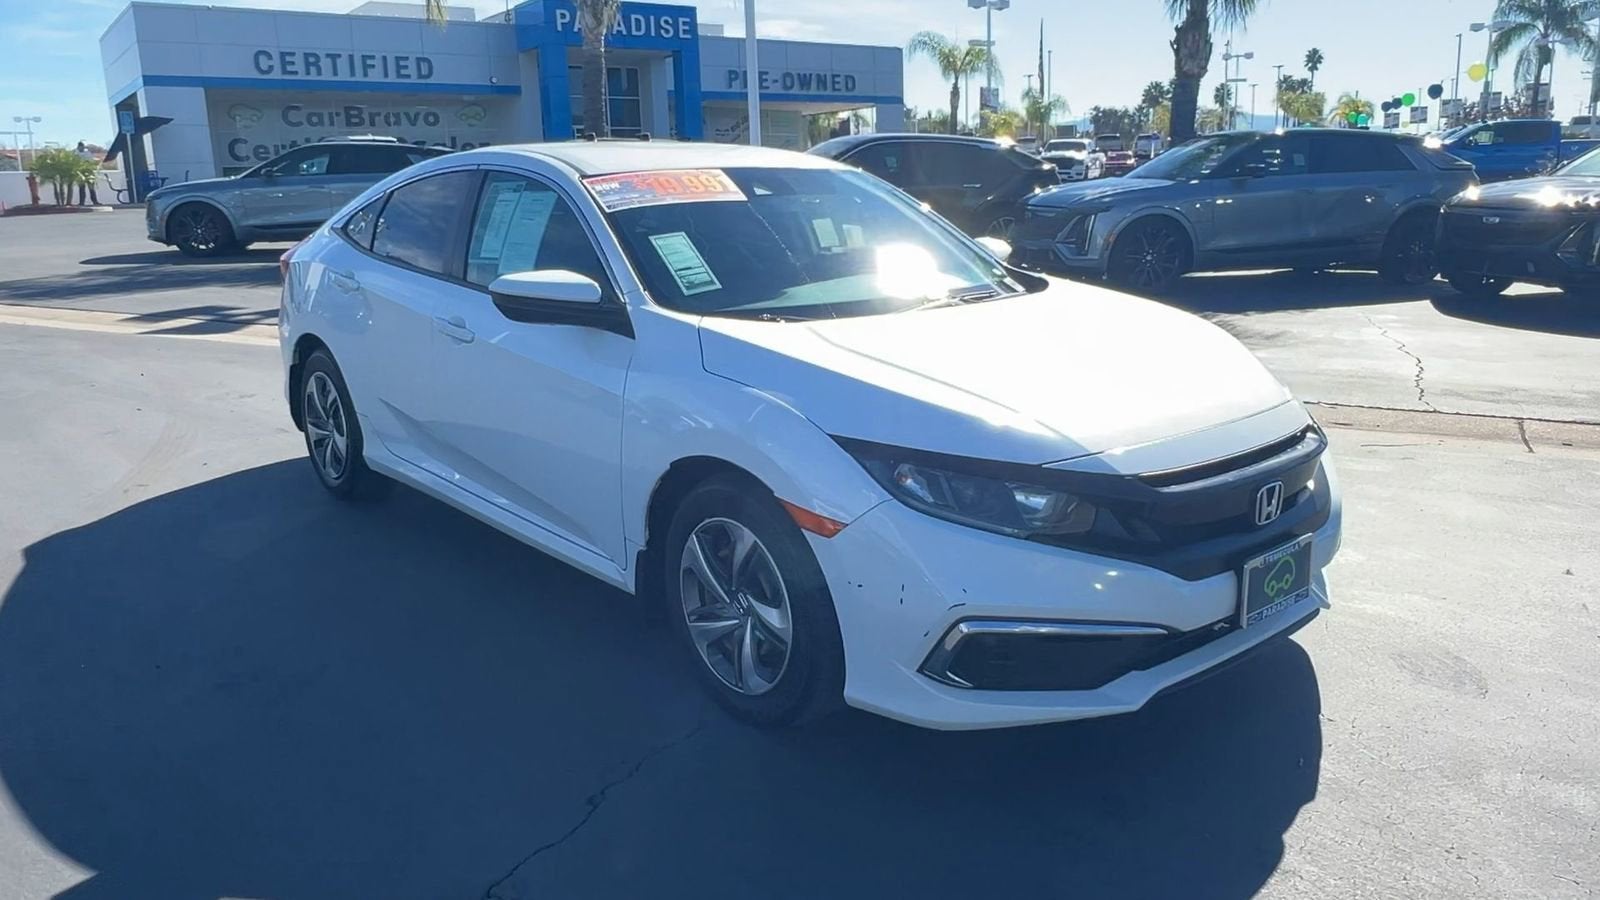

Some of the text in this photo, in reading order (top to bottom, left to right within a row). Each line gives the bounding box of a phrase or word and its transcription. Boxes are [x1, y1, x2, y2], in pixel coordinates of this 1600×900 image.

[555, 9, 692, 39] PAADISE
[253, 50, 434, 79] CERTIFIED
[281, 104, 441, 128] CarBravo
